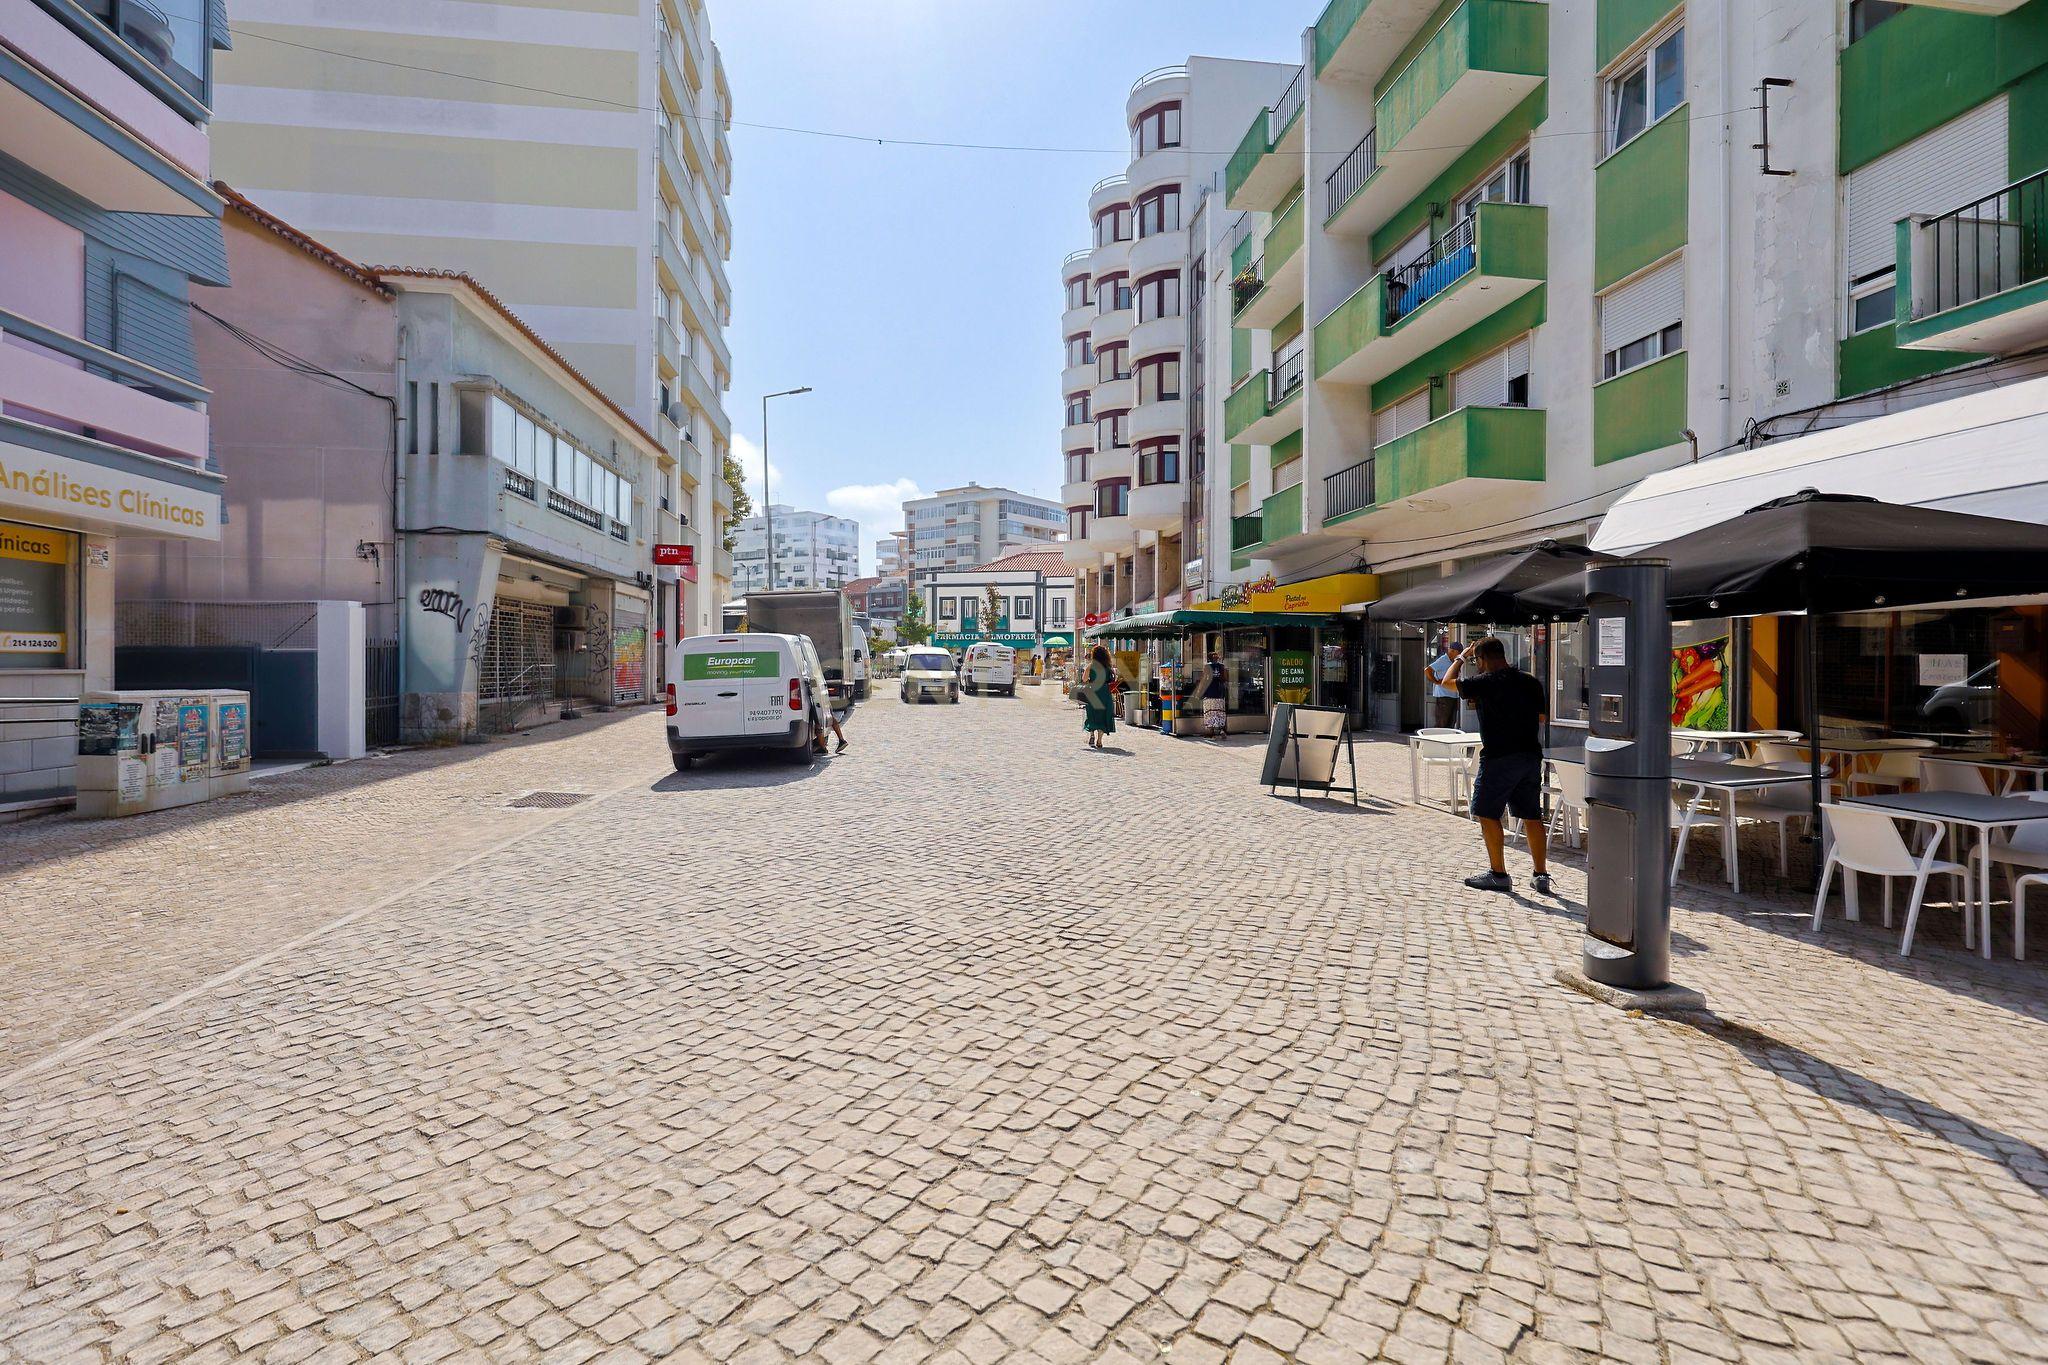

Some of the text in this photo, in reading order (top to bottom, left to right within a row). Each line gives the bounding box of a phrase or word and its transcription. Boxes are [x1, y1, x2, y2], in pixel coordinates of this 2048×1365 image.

[118, 488, 205, 527] Clínicas
[12, 639, 58, 648] 214 124 300
[707, 656, 756, 668] Europcar
[1281, 658, 1304, 667] CALDO
[770, 695, 785, 706] FIAT
